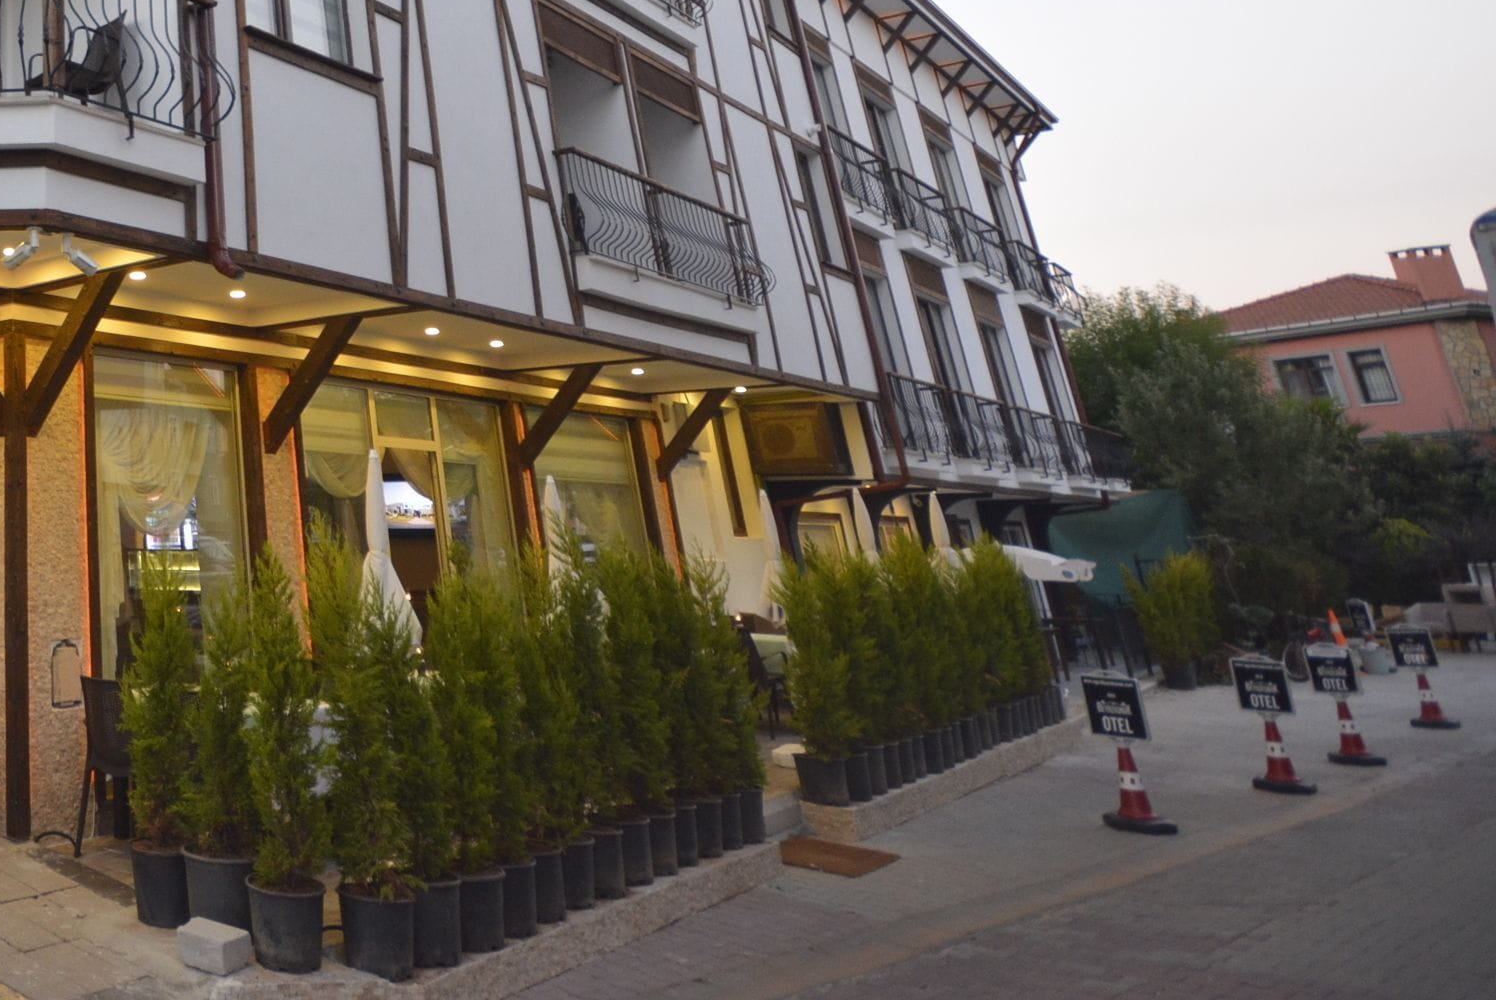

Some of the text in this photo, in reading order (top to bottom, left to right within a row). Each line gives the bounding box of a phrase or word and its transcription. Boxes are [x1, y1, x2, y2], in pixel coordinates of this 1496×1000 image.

[1322, 678, 1349, 690] OTEL
[1250, 693, 1280, 710] OTEL
[1102, 715, 1134, 734] OTEL
